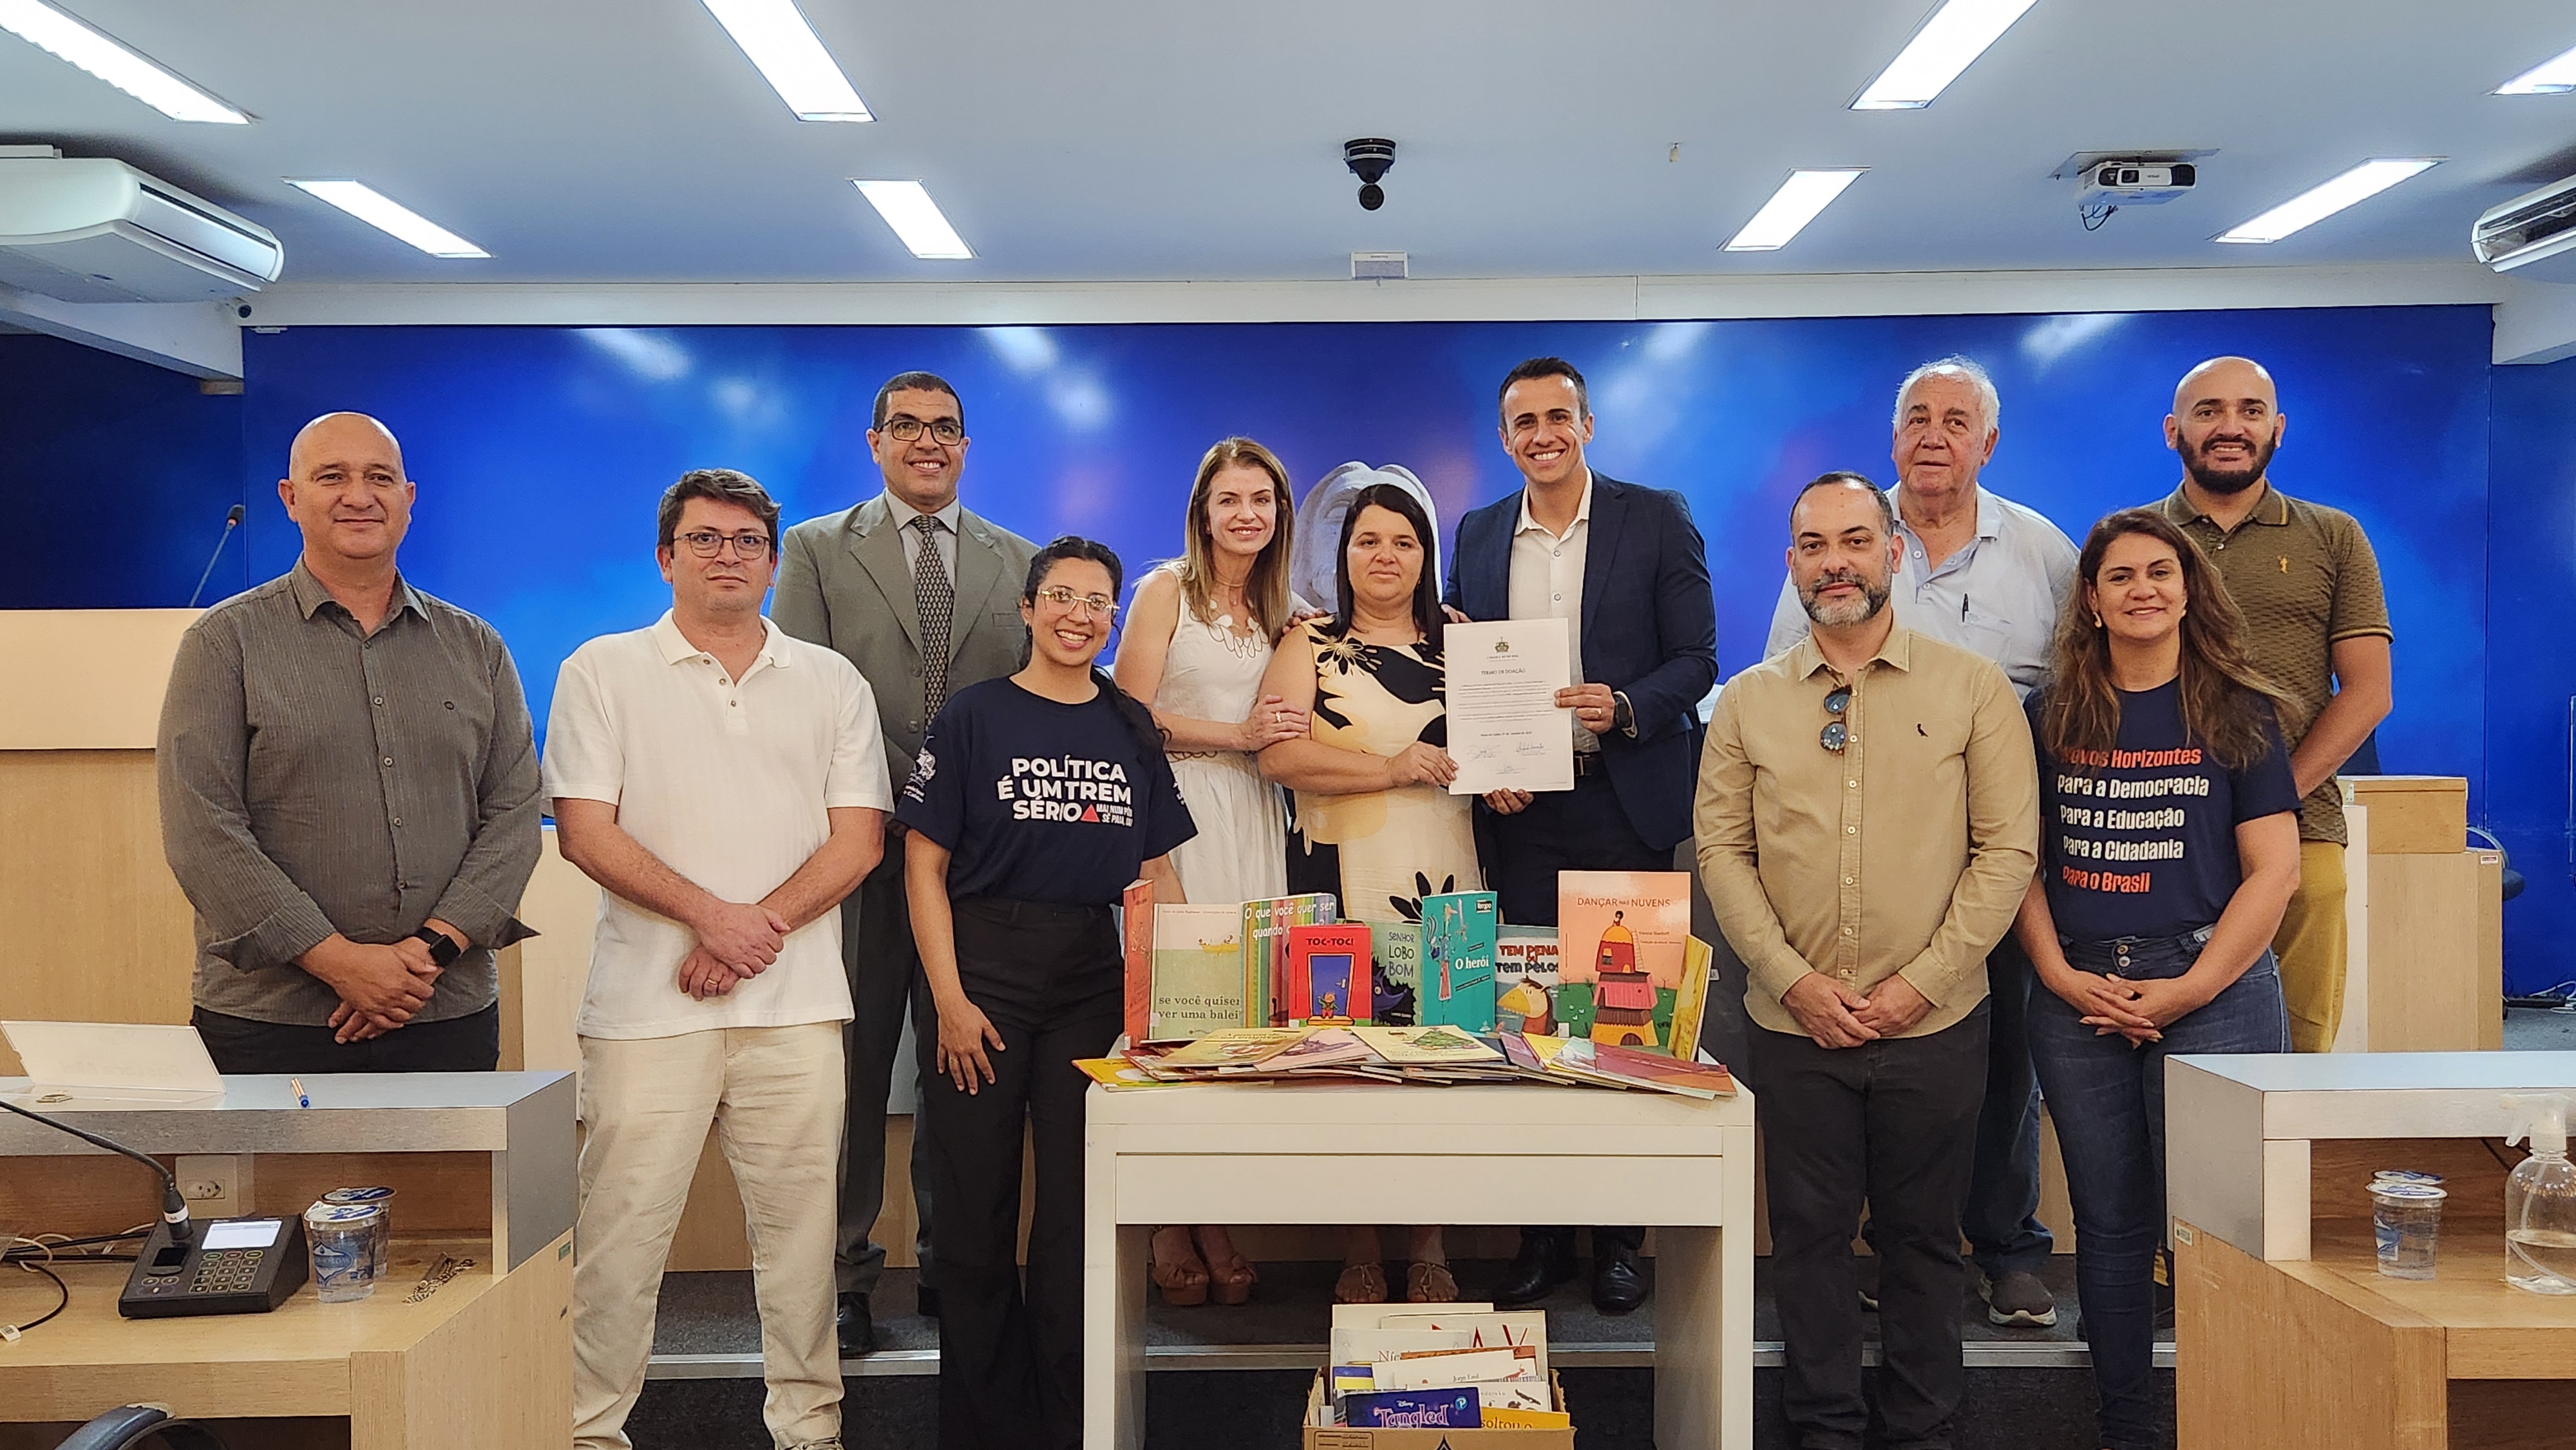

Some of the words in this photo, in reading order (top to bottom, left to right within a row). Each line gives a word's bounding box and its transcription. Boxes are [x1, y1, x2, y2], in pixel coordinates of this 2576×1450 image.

[1012, 754, 1127, 782] POLÍTICA
[2111, 748, 2202, 768] Horizontes
[997, 775, 1014, 800] É
[1022, 780, 1061, 799] UM
[1065, 781, 1131, 804] TREM
[2058, 775, 2092, 795] Para
[2096, 779, 2106, 797] a
[2109, 775, 2210, 798] Democracia
[1012, 795, 1083, 822] SÉRIO
[2060, 805, 2090, 827] Para
[2093, 811, 2104, 828] a
[2107, 807, 2184, 830] Educação
[2063, 836, 2089, 857] Para
[2092, 842, 2102, 859] a
[2105, 840, 2184, 861] Cidadania
[2062, 865, 2088, 889] Para
[2090, 872, 2099, 890] o
[2102, 872, 2150, 892] Brasil
[1244, 907, 1252, 919] O
[1255, 909, 1271, 921] que
[1274, 902, 1294, 916] você
[1297, 904, 1317, 916] quer
[1320, 901, 1335, 912] ser
[1577, 898, 1618, 907] DANÇAR
[1631, 899, 1671, 907] NUVENS
[1253, 924, 1283, 941] quando
[1388, 945, 1415, 959] LOBO
[1499, 945, 1524, 956] TEM
[1526, 945, 1558, 957] PENA
[1388, 961, 1414, 978] BOM
[1455, 958, 1464, 970] O
[1465, 954, 1490, 969] herói
[1175, 995, 1201, 1005] você
[1209, 1010, 1238, 1019] balei
[1374, 1404, 1450, 1428] Tangled
